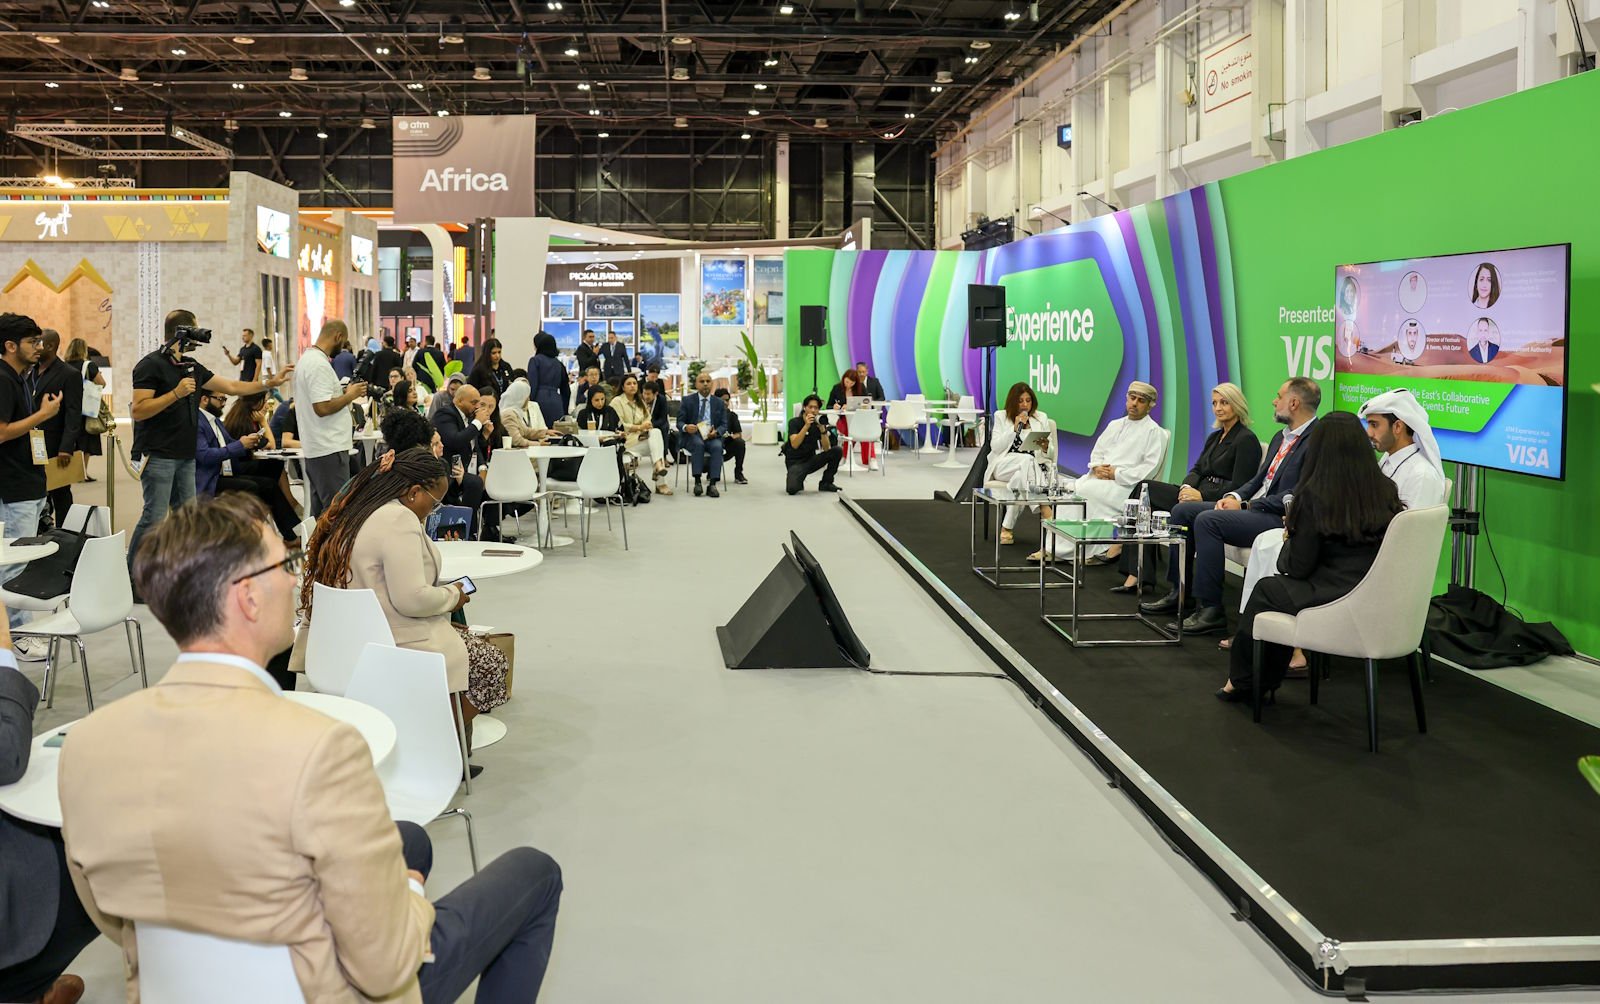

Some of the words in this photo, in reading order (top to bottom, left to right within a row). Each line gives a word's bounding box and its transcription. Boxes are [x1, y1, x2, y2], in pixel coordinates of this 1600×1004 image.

[1221, 79, 1230, 91] No
[1231, 69, 1252, 86] smokin
[410, 121, 429, 129] atm
[419, 167, 509, 192] Africa
[569, 272, 634, 280] PICKALBATROS
[1279, 305, 1335, 323] Presented
[1006, 302, 1094, 350] Experience
[1280, 335, 1335, 380] VIS
[1029, 354, 1060, 395] Hub
[1339, 383, 1360, 394] Beyond
[1442, 392, 1490, 405] Collaborative
[1342, 393, 1359, 402] Vision
[1360, 394, 1368, 403] for
[1422, 401, 1444, 411] Events
[1446, 404, 1469, 414] Future
[1505, 442, 1549, 469] VISA
